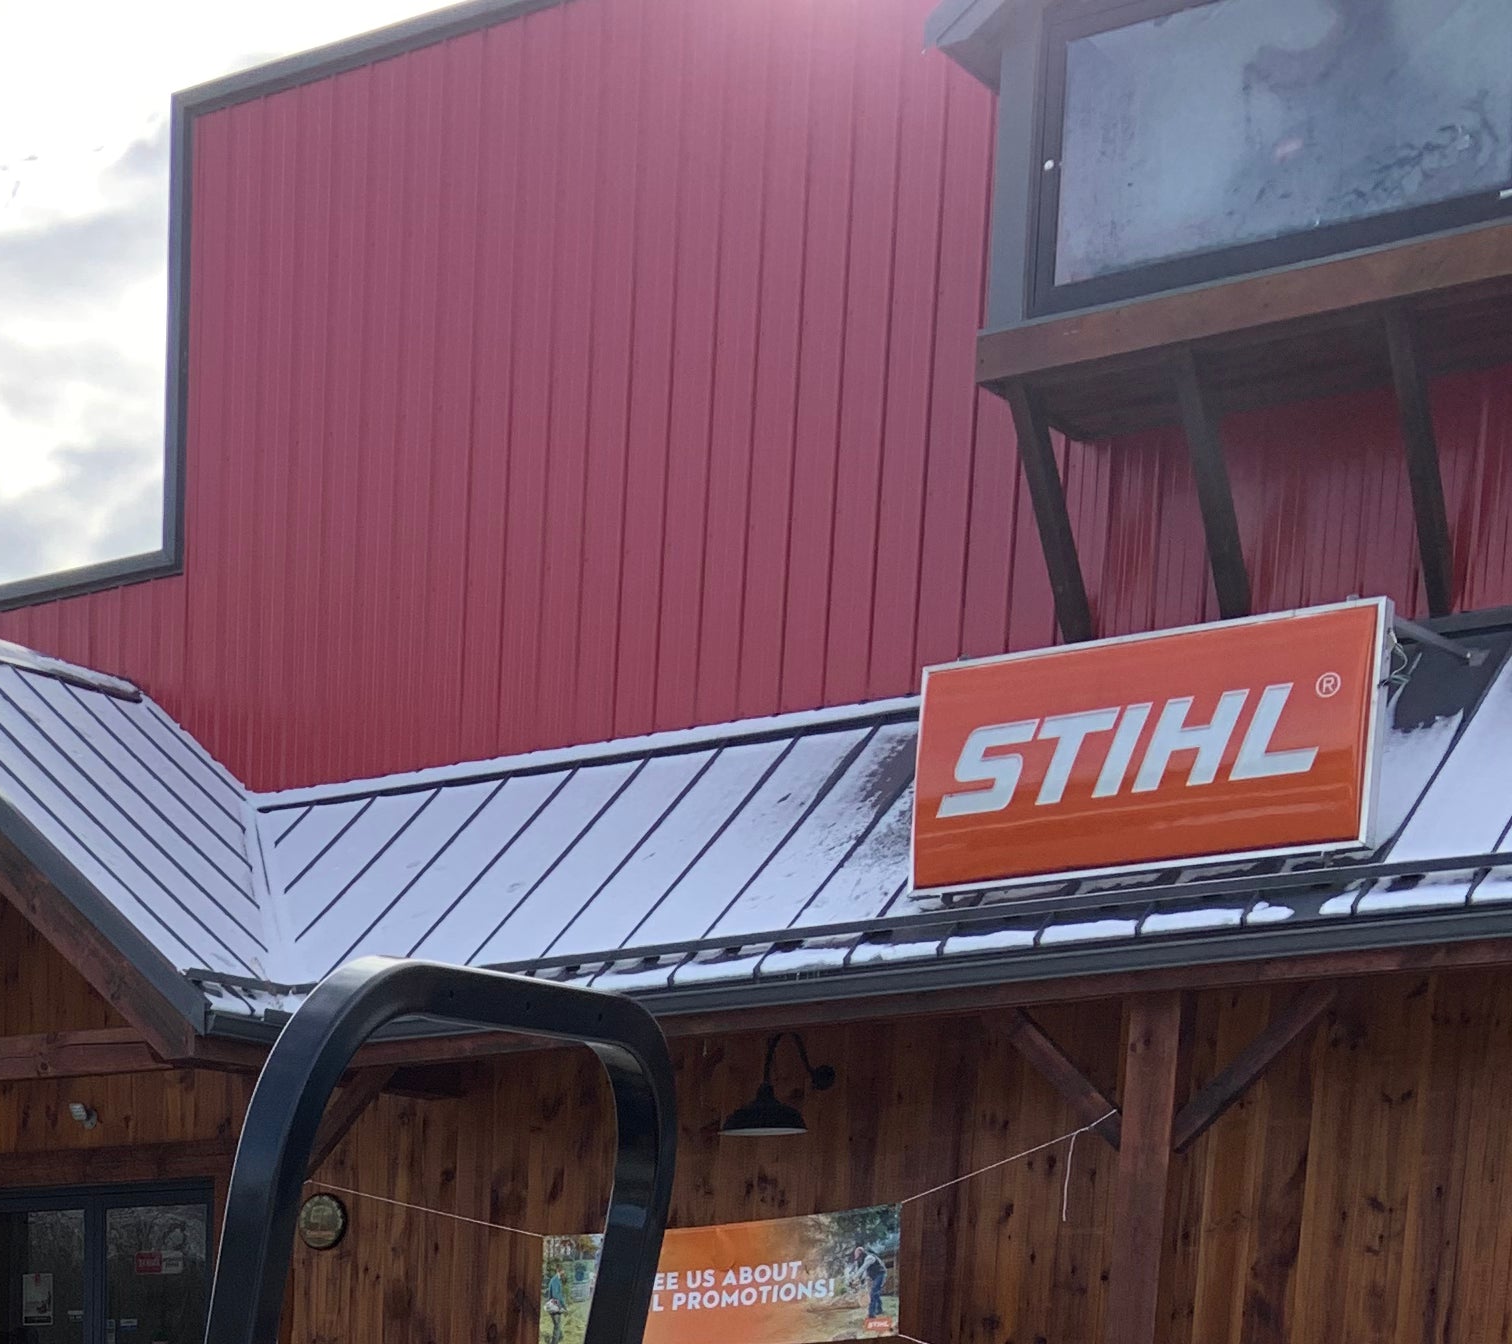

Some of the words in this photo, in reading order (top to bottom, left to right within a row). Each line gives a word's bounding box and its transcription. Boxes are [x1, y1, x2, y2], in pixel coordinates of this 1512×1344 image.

[936, 682, 1320, 818] STIHL
[653, 1271, 679, 1291] EE
[687, 1269, 715, 1289] US
[721, 1260, 802, 1286] ABOUT
[672, 1278, 836, 1312] PROMOTIONS!
